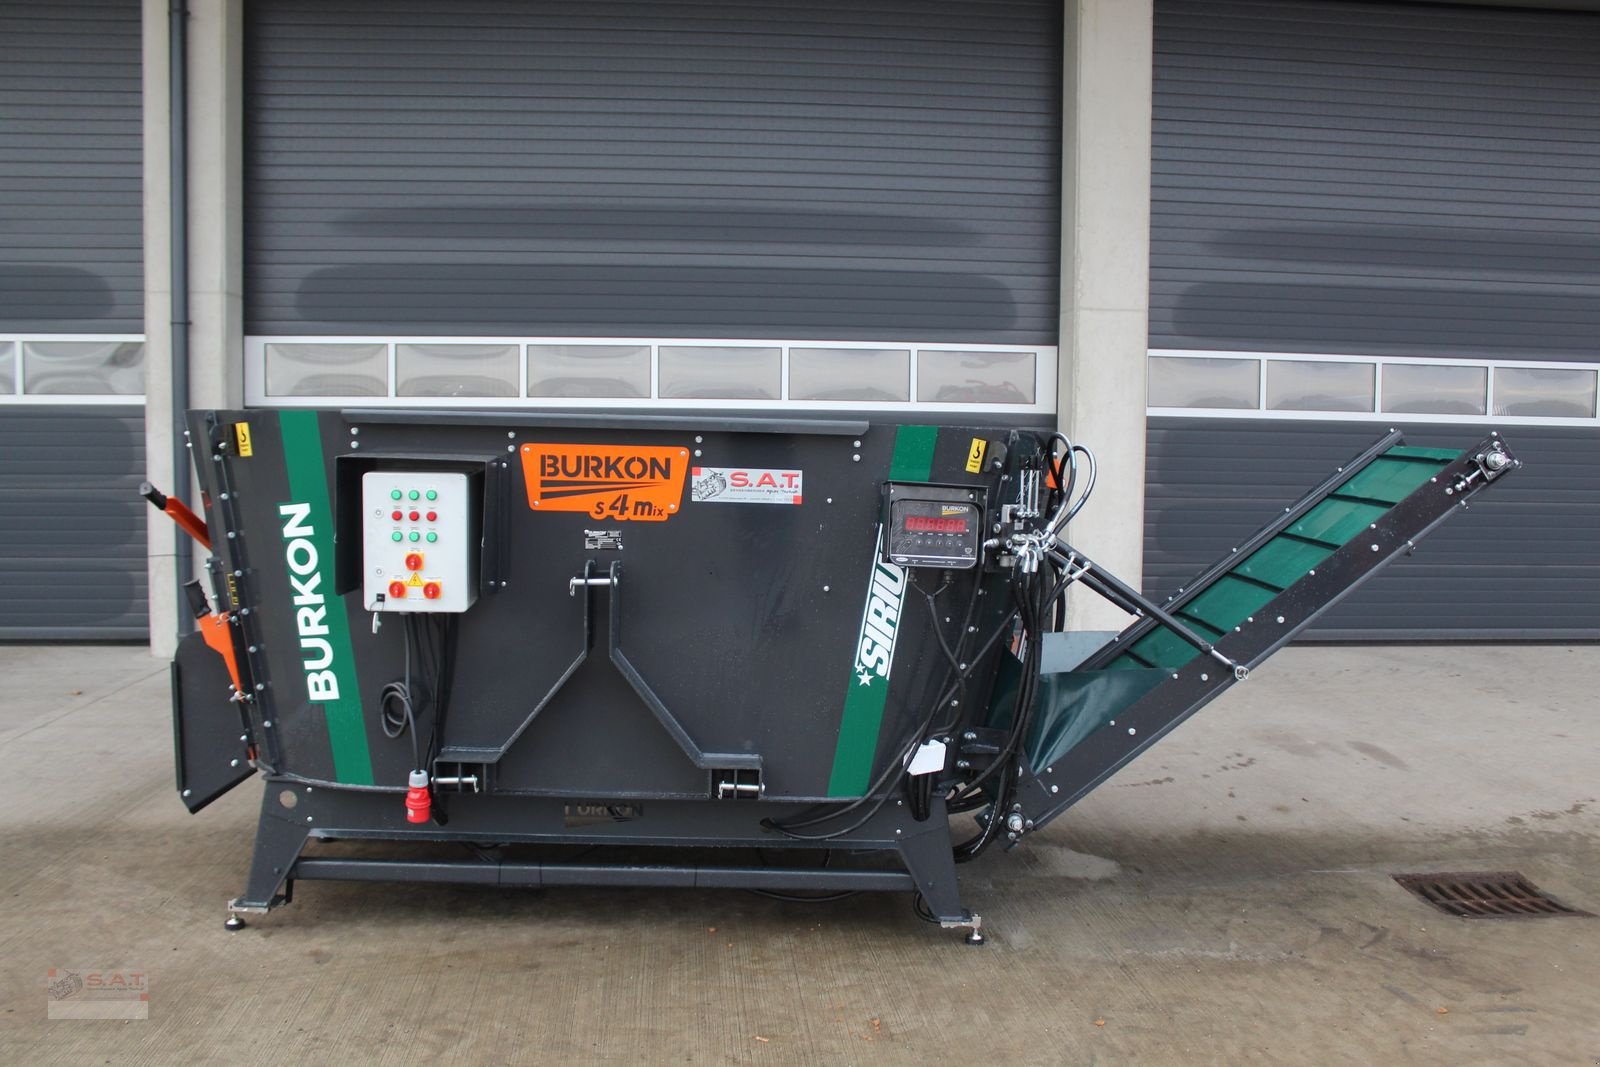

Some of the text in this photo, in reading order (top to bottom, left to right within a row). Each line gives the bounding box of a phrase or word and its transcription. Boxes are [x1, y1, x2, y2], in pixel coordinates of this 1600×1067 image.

[540, 454, 671, 480] BURKON
[729, 471, 800, 489] S.A.T.
[279, 502, 340, 700] BURKON
[860, 545, 905, 677] SIRIU
